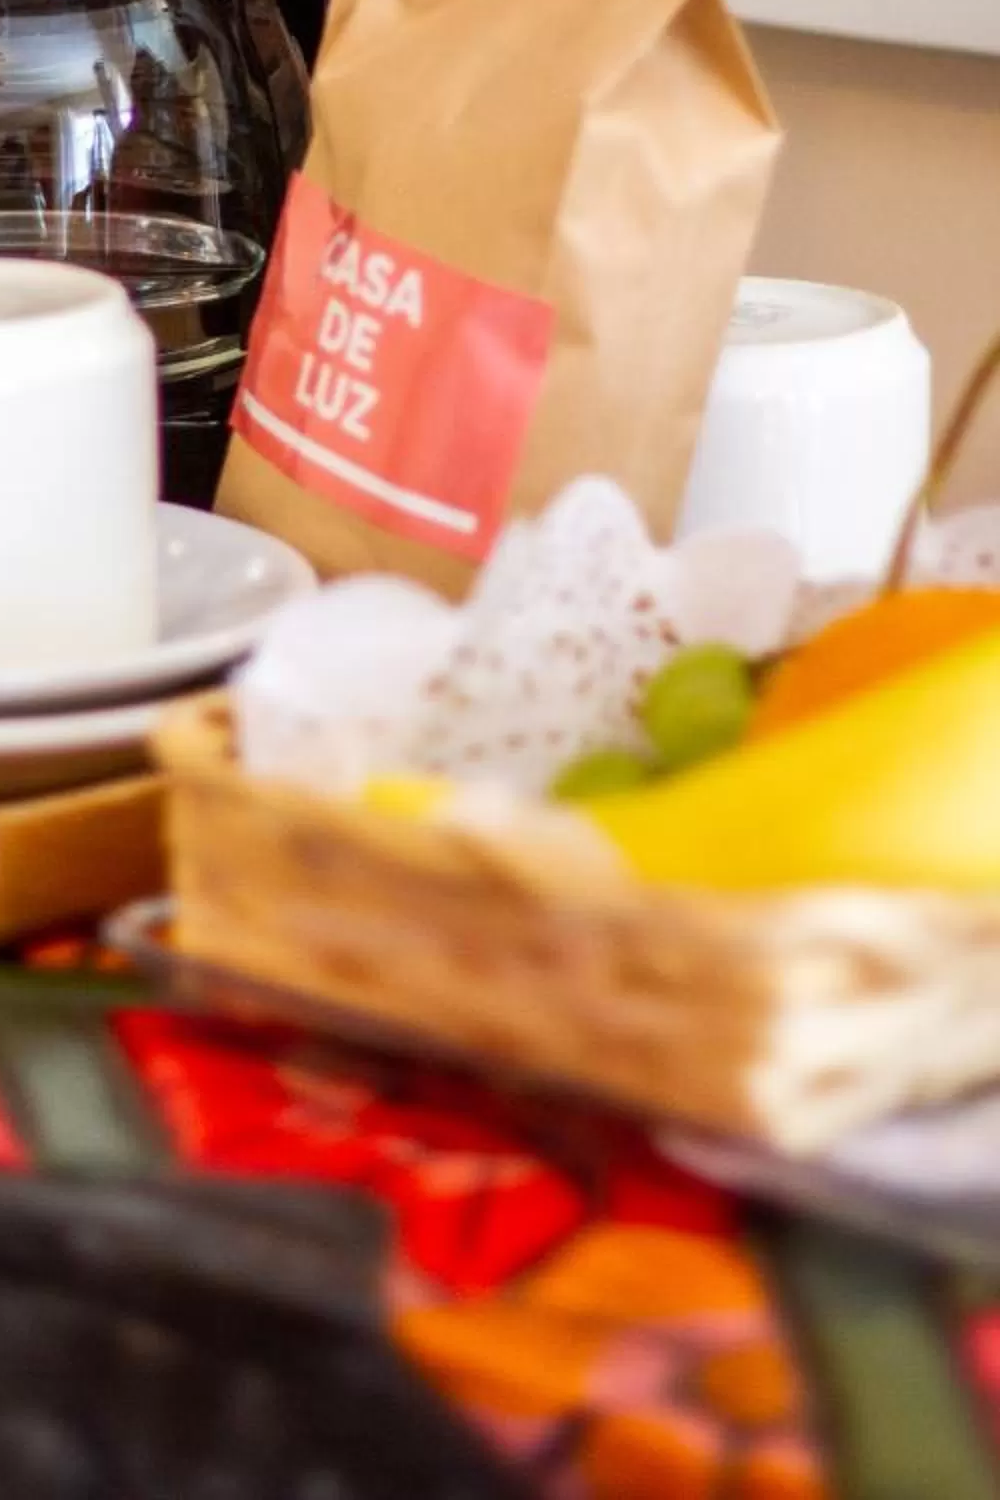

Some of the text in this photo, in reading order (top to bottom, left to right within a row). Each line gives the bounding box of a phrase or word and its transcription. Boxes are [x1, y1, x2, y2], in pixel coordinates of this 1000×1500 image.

[320, 231, 424, 329] CASA
[316, 297, 382, 372] DE
[293, 352, 381, 443] LUZ
